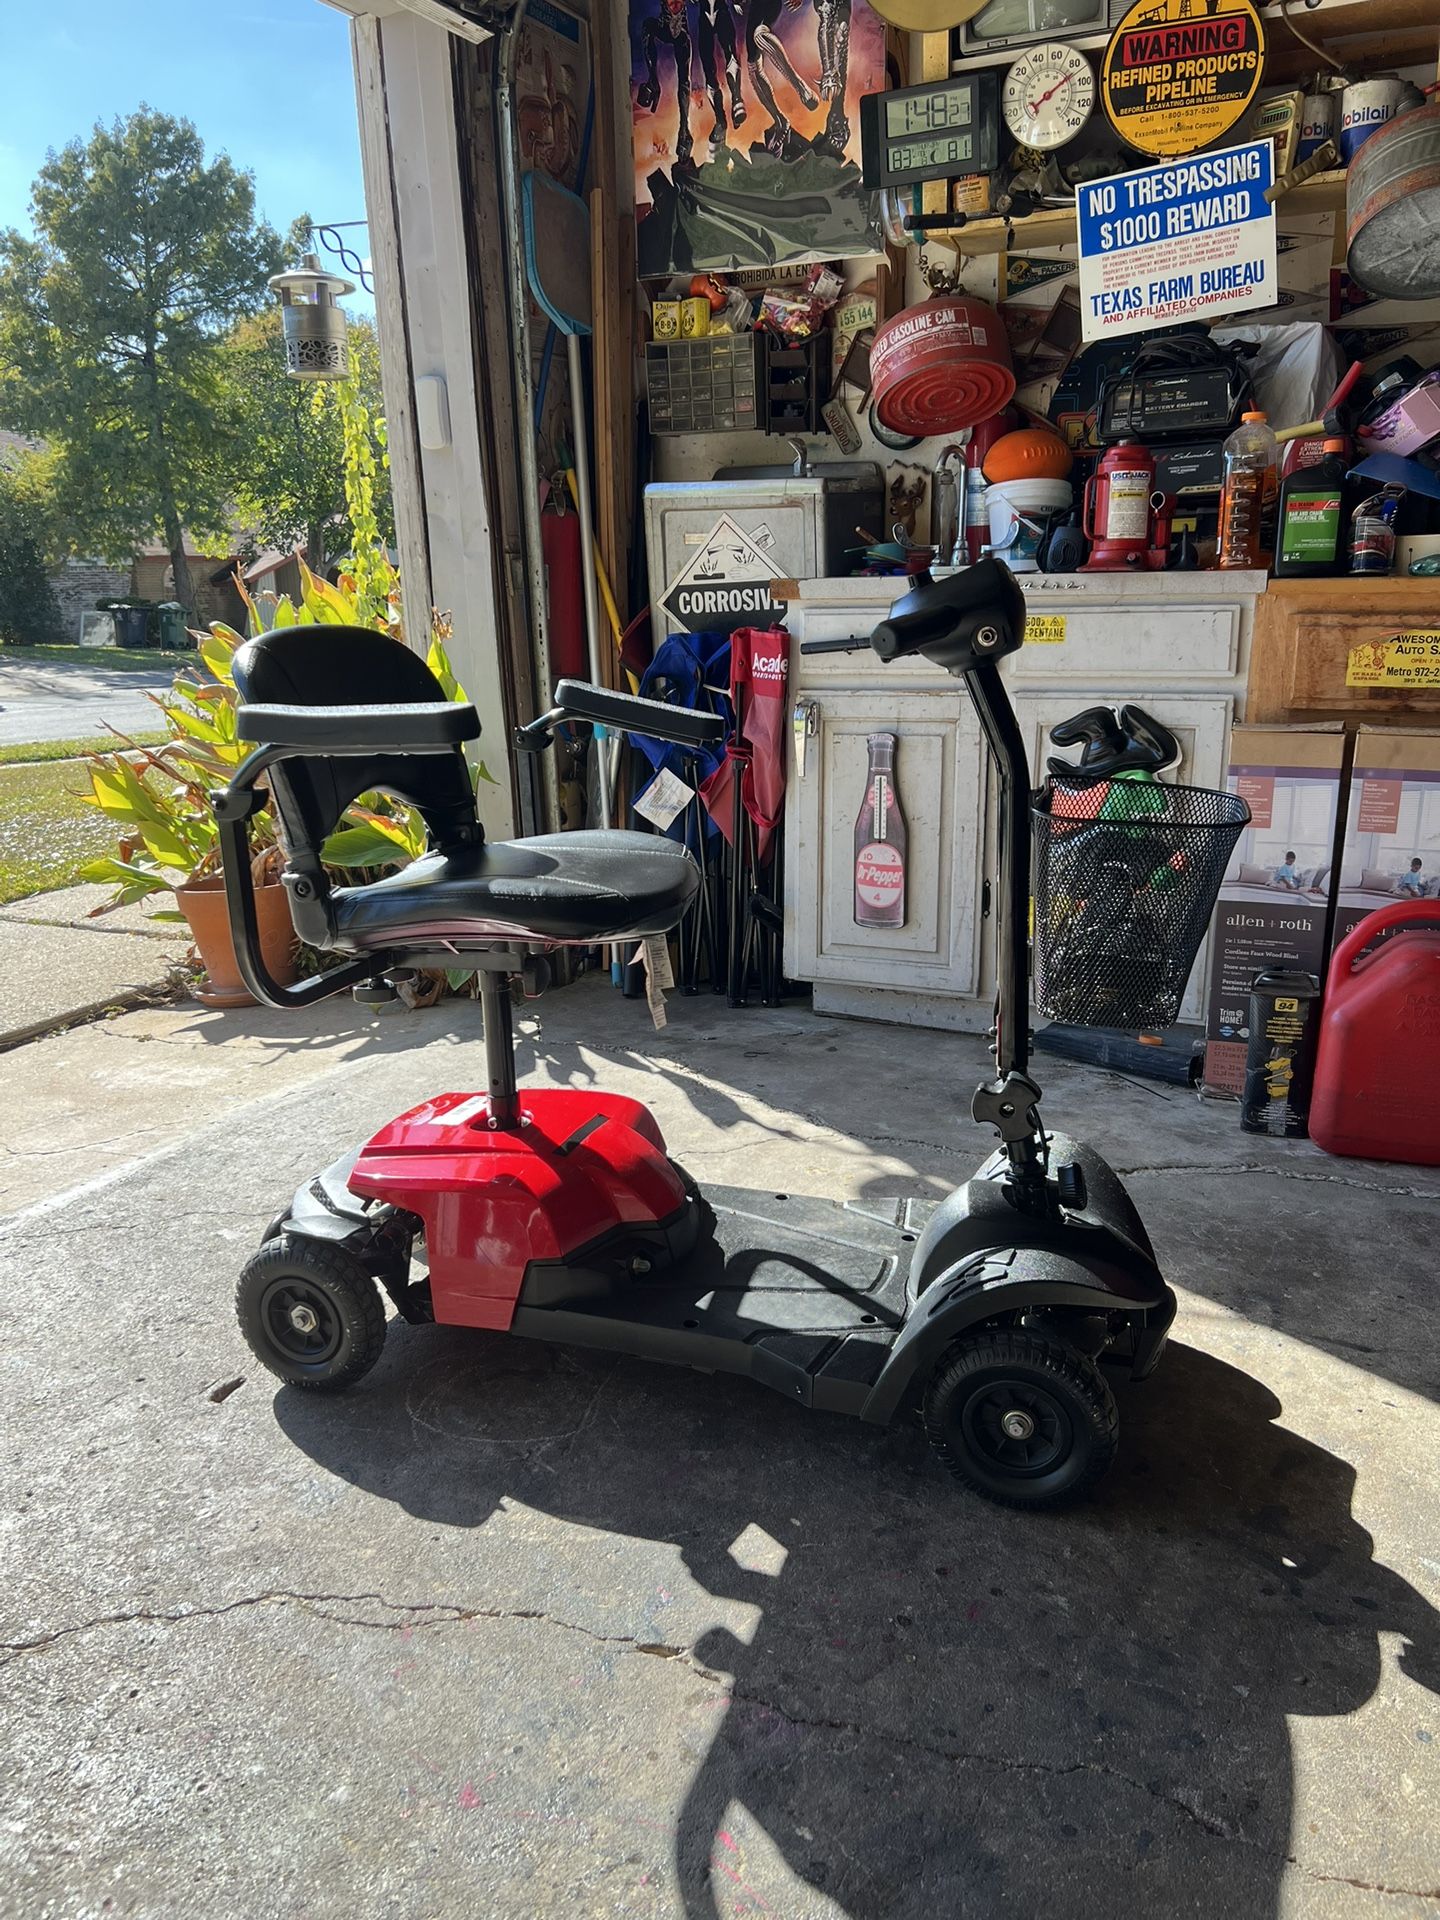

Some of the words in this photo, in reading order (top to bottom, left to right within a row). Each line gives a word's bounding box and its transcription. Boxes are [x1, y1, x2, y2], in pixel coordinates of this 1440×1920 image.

[1128, 22, 1239, 62] WARNING
[1033, 54, 1044, 63] 40
[1051, 51, 1063, 60] 60
[1015, 67, 1027, 76] 20
[1069, 59, 1080, 68] 80
[1111, 64, 1172, 89] REFINED
[1176, 51, 1256, 79] PRODUCTS
[1009, 87, 1015, 96] 0
[1077, 76, 1091, 86] 100
[1146, 77, 1217, 103] PIPELINE
[1077, 98, 1091, 108] 120
[1120, 104, 1144, 115] BEFORE
[1146, 99, 1184, 110] EXCAVATING
[1204, 91, 1243, 103] EMERGENCY
[905, 93, 947, 131] 1:48
[1140, 115, 1154, 123] Call
[1161, 106, 1219, 120] 1-800-537-5200
[1066, 117, 1081, 127] 140
[1195, 120, 1223, 130] Company
[893, 149, 911, 170] 83
[1089, 185, 1116, 217] NO
[1124, 151, 1260, 209] TRESPASSING
[1101, 211, 1161, 250] $1000
[1167, 191, 1250, 235] REWARD
[780, 267, 792, 279] LA
[1041, 262, 1076, 274] PACKERS
[1090, 286, 1143, 317] TEXAS
[1149, 275, 1193, 305] FARM
[1200, 259, 1265, 295] BUREAU
[858, 306, 874, 321] 144
[1103, 312, 1124, 325] AND
[1126, 299, 1187, 320] AFFILIATED
[1190, 286, 1253, 306] COMPANIES
[889, 314, 932, 341] GASOLINE
[935, 309, 955, 324] CAN
[1395, 645, 1425, 655] AUTO
[1430, 645, 1440, 656] S
[752, 653, 789, 673] Acade
[1387, 666, 1412, 676] Metro
[864, 853, 873, 861] 10
[891, 854, 896, 863] 2
[866, 866, 902, 885] Pepper
[873, 893, 881, 901] 4
[1226, 914, 1264, 927] allen
[1279, 919, 1312, 931] roth
[1220, 1016, 1243, 1025] HOME!
